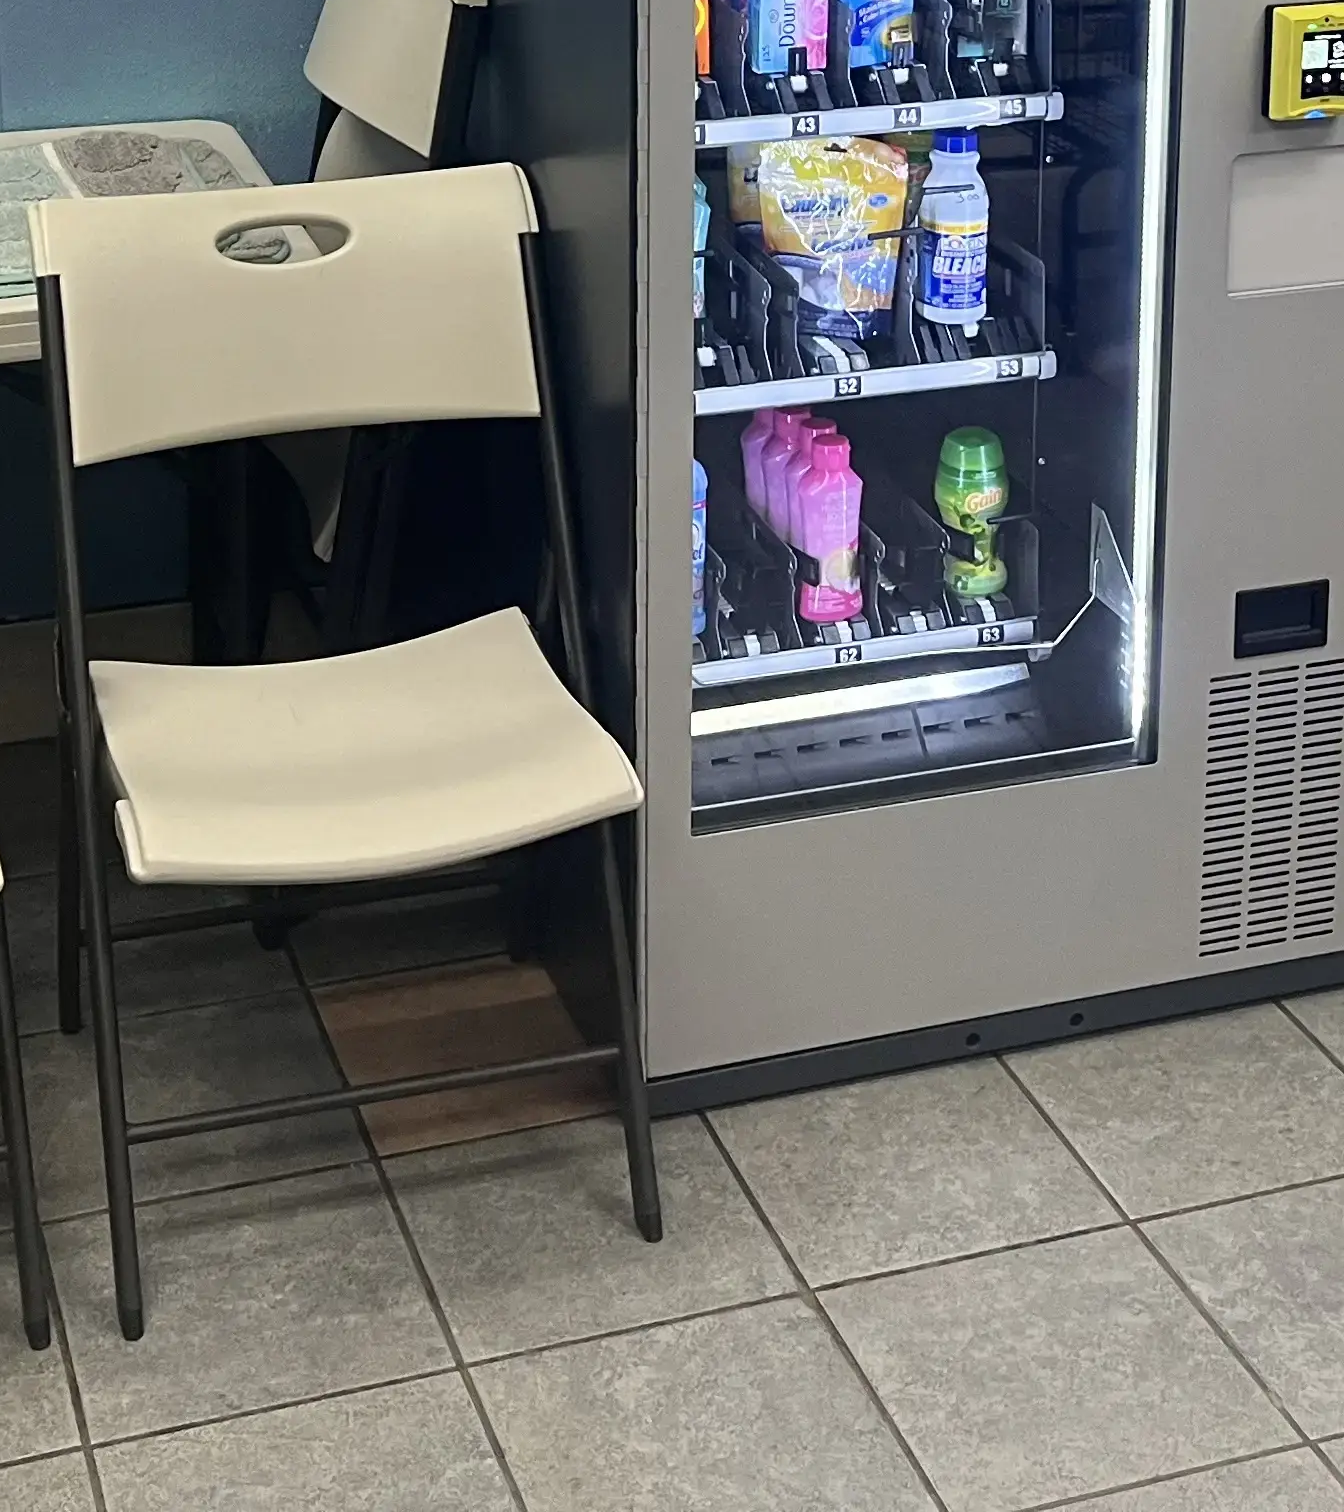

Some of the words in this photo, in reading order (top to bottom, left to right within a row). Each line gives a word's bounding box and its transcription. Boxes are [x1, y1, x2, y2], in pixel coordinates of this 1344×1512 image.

[1003, 99, 1022, 115] 45
[898, 109, 917, 124] 44
[796, 117, 815, 133] 43
[1000, 361, 1019, 376] 53
[838, 378, 857, 394] 52
[966, 487, 1003, 513] Gain
[982, 628, 1000, 642] 63
[839, 648, 857, 663] 62
